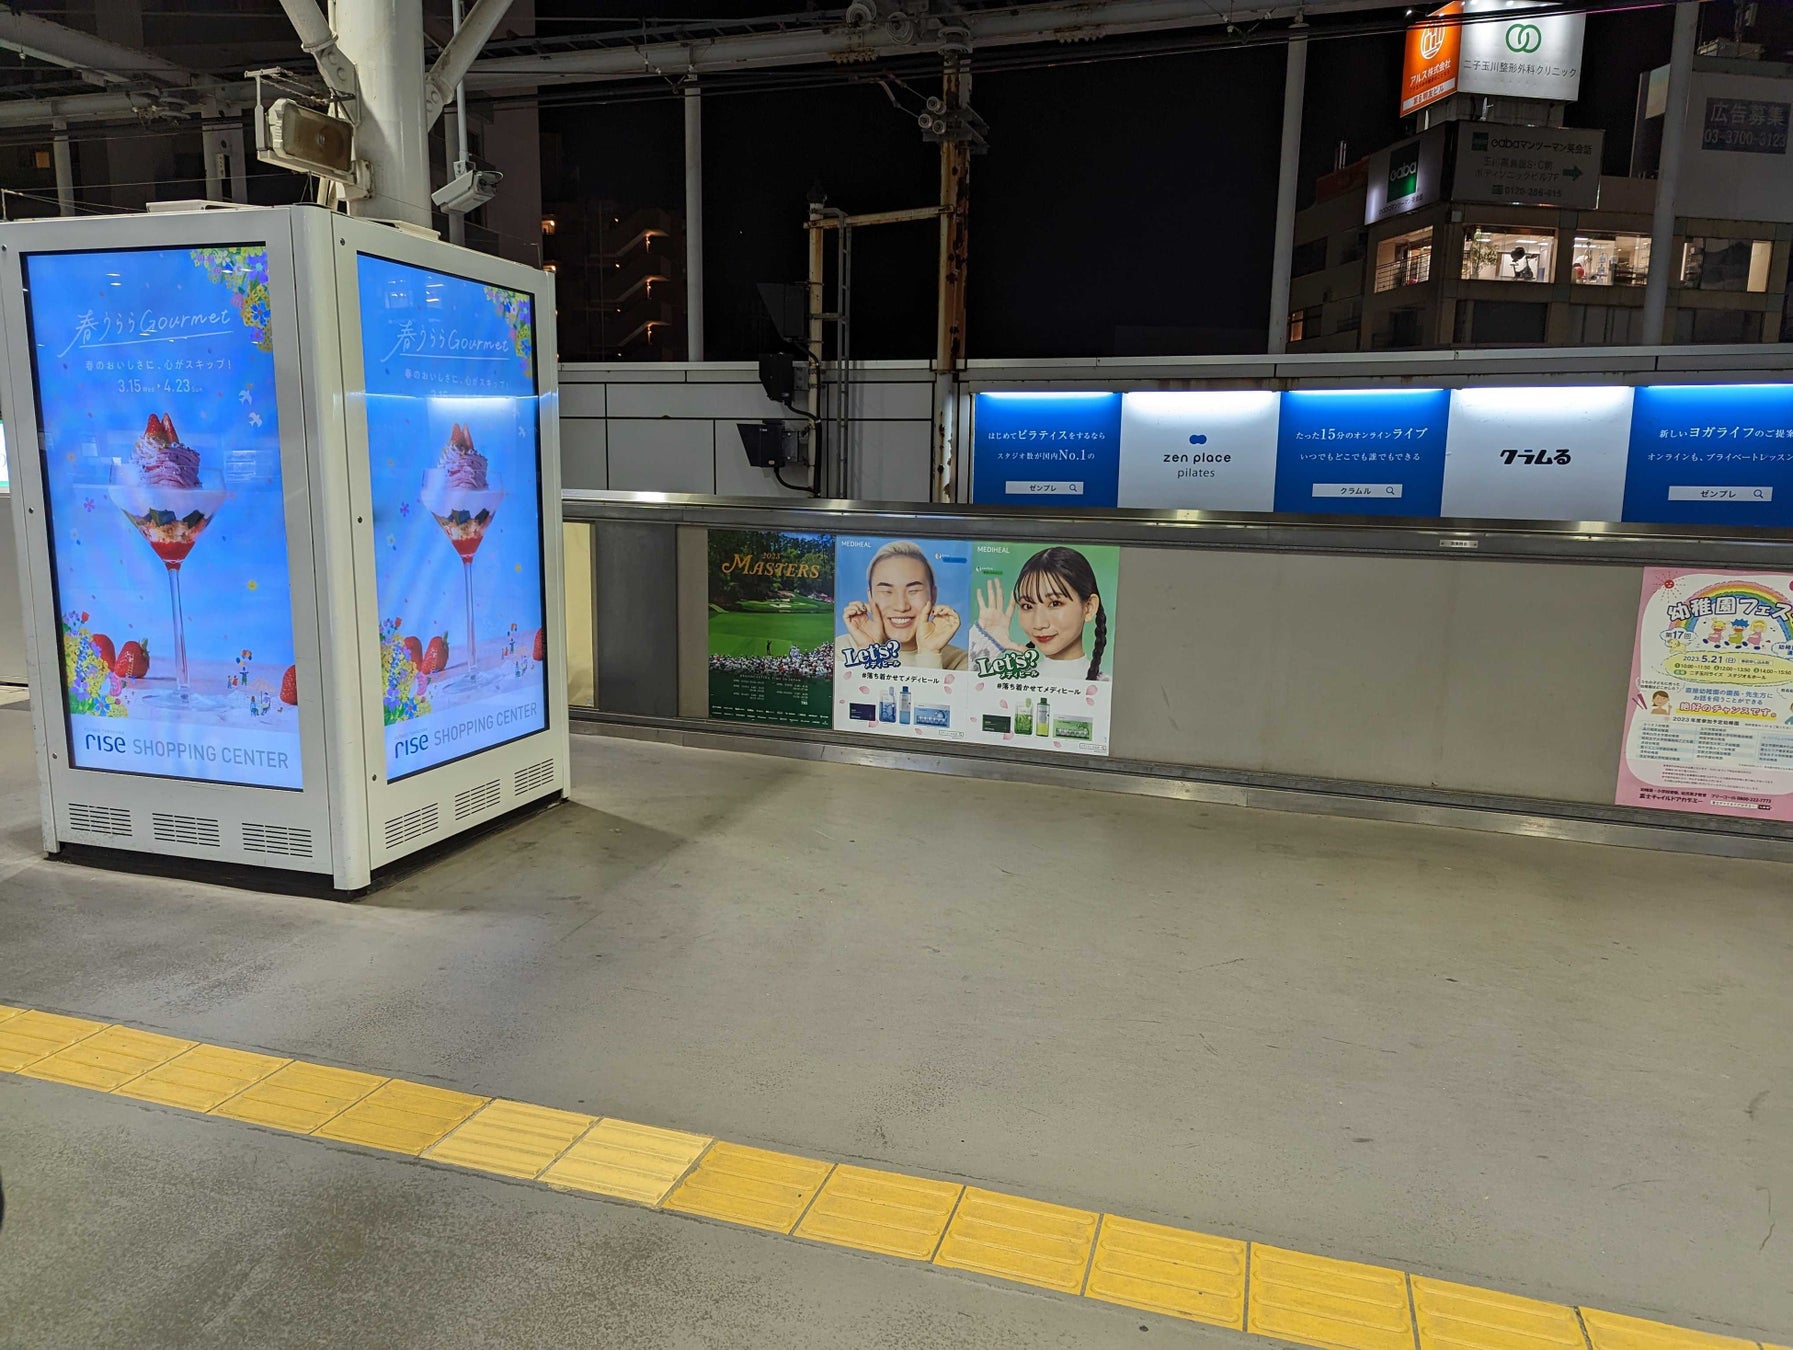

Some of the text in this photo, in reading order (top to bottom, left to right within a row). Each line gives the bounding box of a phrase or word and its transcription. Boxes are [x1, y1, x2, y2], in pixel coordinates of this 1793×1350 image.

[1463, 60, 1577, 78] 二子玉川整形外科クリニック
[1711, 102, 1785, 126] 広告募集
[118, 378, 141, 393] 3.15
[163, 378, 190, 393] 4.23
[988, 429, 1106, 441] はじめてピラティスをするなら
[1296, 427, 1428, 441] たった15分のオンラインライブ
[997, 448, 1095, 461] スタジオ数が国内No.1の
[1163, 451, 1232, 465] zen place
[1300, 451, 1421, 462] いつでもどこでも誰でもできる
[1177, 468, 1216, 480] pilates
[1029, 484, 1057, 493] ゼンプレ
[1340, 486, 1372, 496] クラムル
[1700, 489, 1737, 499] ゼンプレ
[841, 541, 871, 549] MEDIHEAL
[977, 546, 1010, 554] MEDIHEAL
[1667, 596, 1793, 623] 幼稚園フェス
[842, 640, 901, 668] Let's?
[976, 649, 1040, 678] Let's?
[862, 672, 940, 684] #落ち着かせてメディヒール
[997, 682, 1081, 695] #落ち着かせてメディヒール
[1679, 702, 1777, 718] 絶好のチャンスです。
[394, 733, 429, 759] rise
[434, 715, 494, 746] SHOPPING
[496, 702, 538, 727] CENTER
[85, 733, 289, 769] rise SHOPPING CENTER
